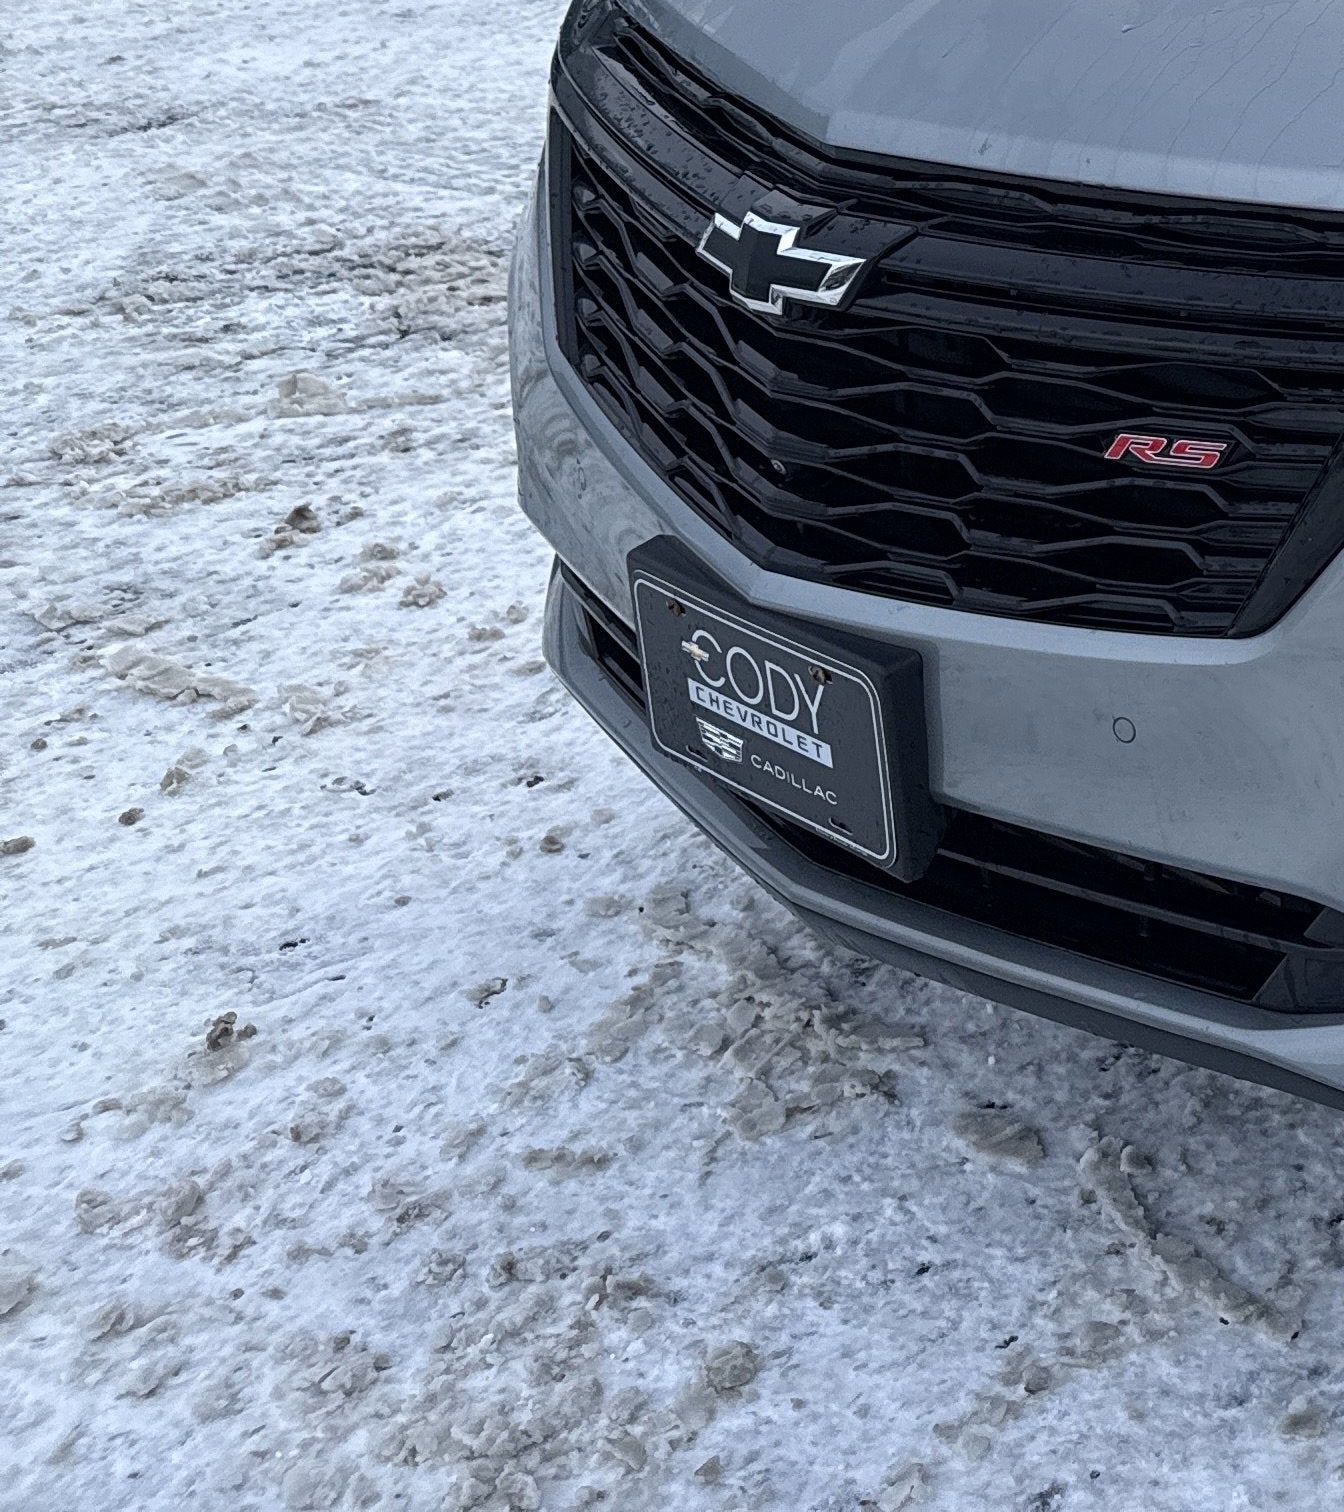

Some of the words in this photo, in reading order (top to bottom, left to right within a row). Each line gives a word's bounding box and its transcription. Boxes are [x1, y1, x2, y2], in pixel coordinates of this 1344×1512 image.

[1104, 433, 1227, 469] RS
[682, 629, 825, 735] CODY
[695, 684, 824, 759] CHEVROLET
[750, 754, 839, 806] CADILLAC
